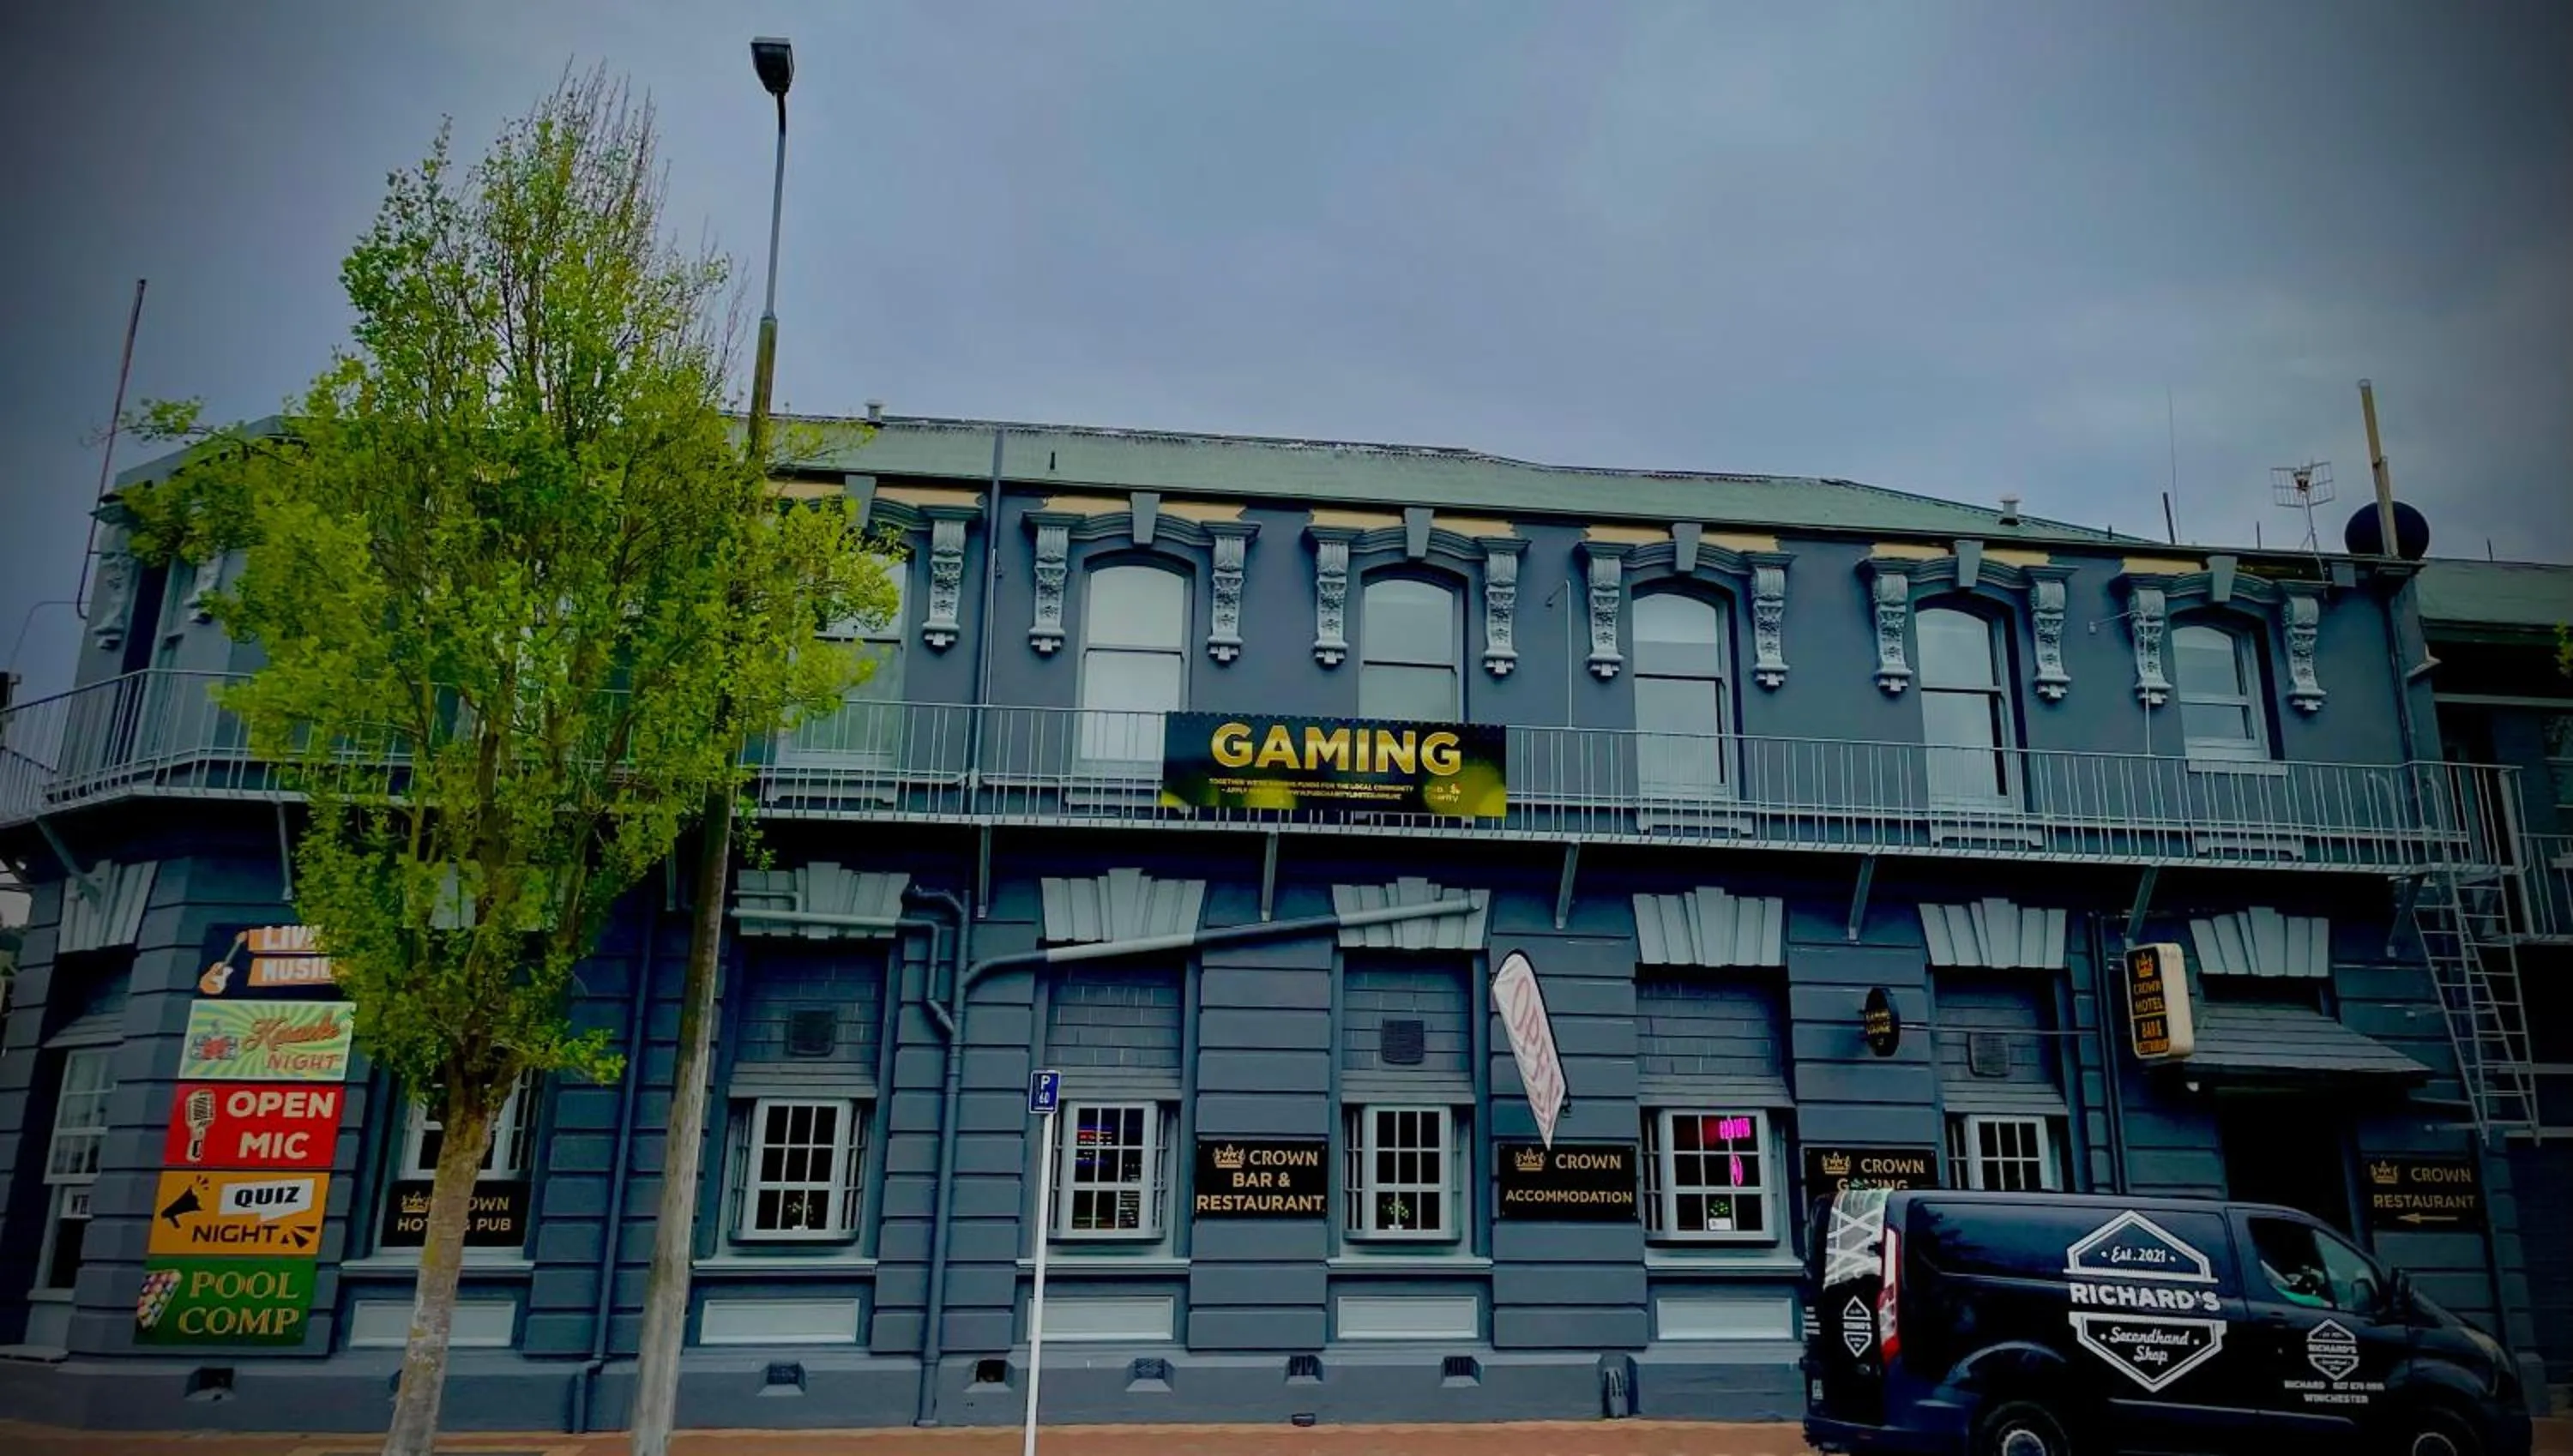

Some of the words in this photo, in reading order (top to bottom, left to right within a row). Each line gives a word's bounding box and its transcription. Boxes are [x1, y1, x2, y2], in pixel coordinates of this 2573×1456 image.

[1211, 722, 1461, 776] GAMING
[2134, 980, 2162, 995] CROWN
[2135, 997, 2164, 1014] HOTEL
[267, 1054, 338, 1071] NIGHT
[1040, 1074, 1051, 1090] P
[226, 1091, 335, 1119] OPEN
[238, 1132, 310, 1159] MIC
[1249, 1150, 1318, 1167] CROWN
[1555, 1153, 1623, 1170] CROWN
[1860, 1158, 1925, 1174] CROWN
[1232, 1172, 1273, 1188] BAR
[1278, 1172, 1291, 1188] &
[2411, 1167, 2473, 1182] CROWN
[1836, 1177, 1909, 1192] GING
[234, 1186, 300, 1207] QUIZ
[1196, 1194, 1325, 1212] RESTAURANT
[1505, 1188, 1633, 1204] ACCOMMODATION
[2373, 1194, 2476, 1209] RESTAURANT
[192, 1224, 280, 1243] NIGHT
[476, 1218, 512, 1232] PUB
[188, 1271, 299, 1299] POOL
[2069, 1282, 2221, 1311] RICHARD'S
[178, 1306, 300, 1335] COMP
[2109, 1327, 2190, 1345] Secondhand
[2133, 1345, 2168, 1365] Shop
[2303, 1393, 2370, 1405] WINCHESTER
